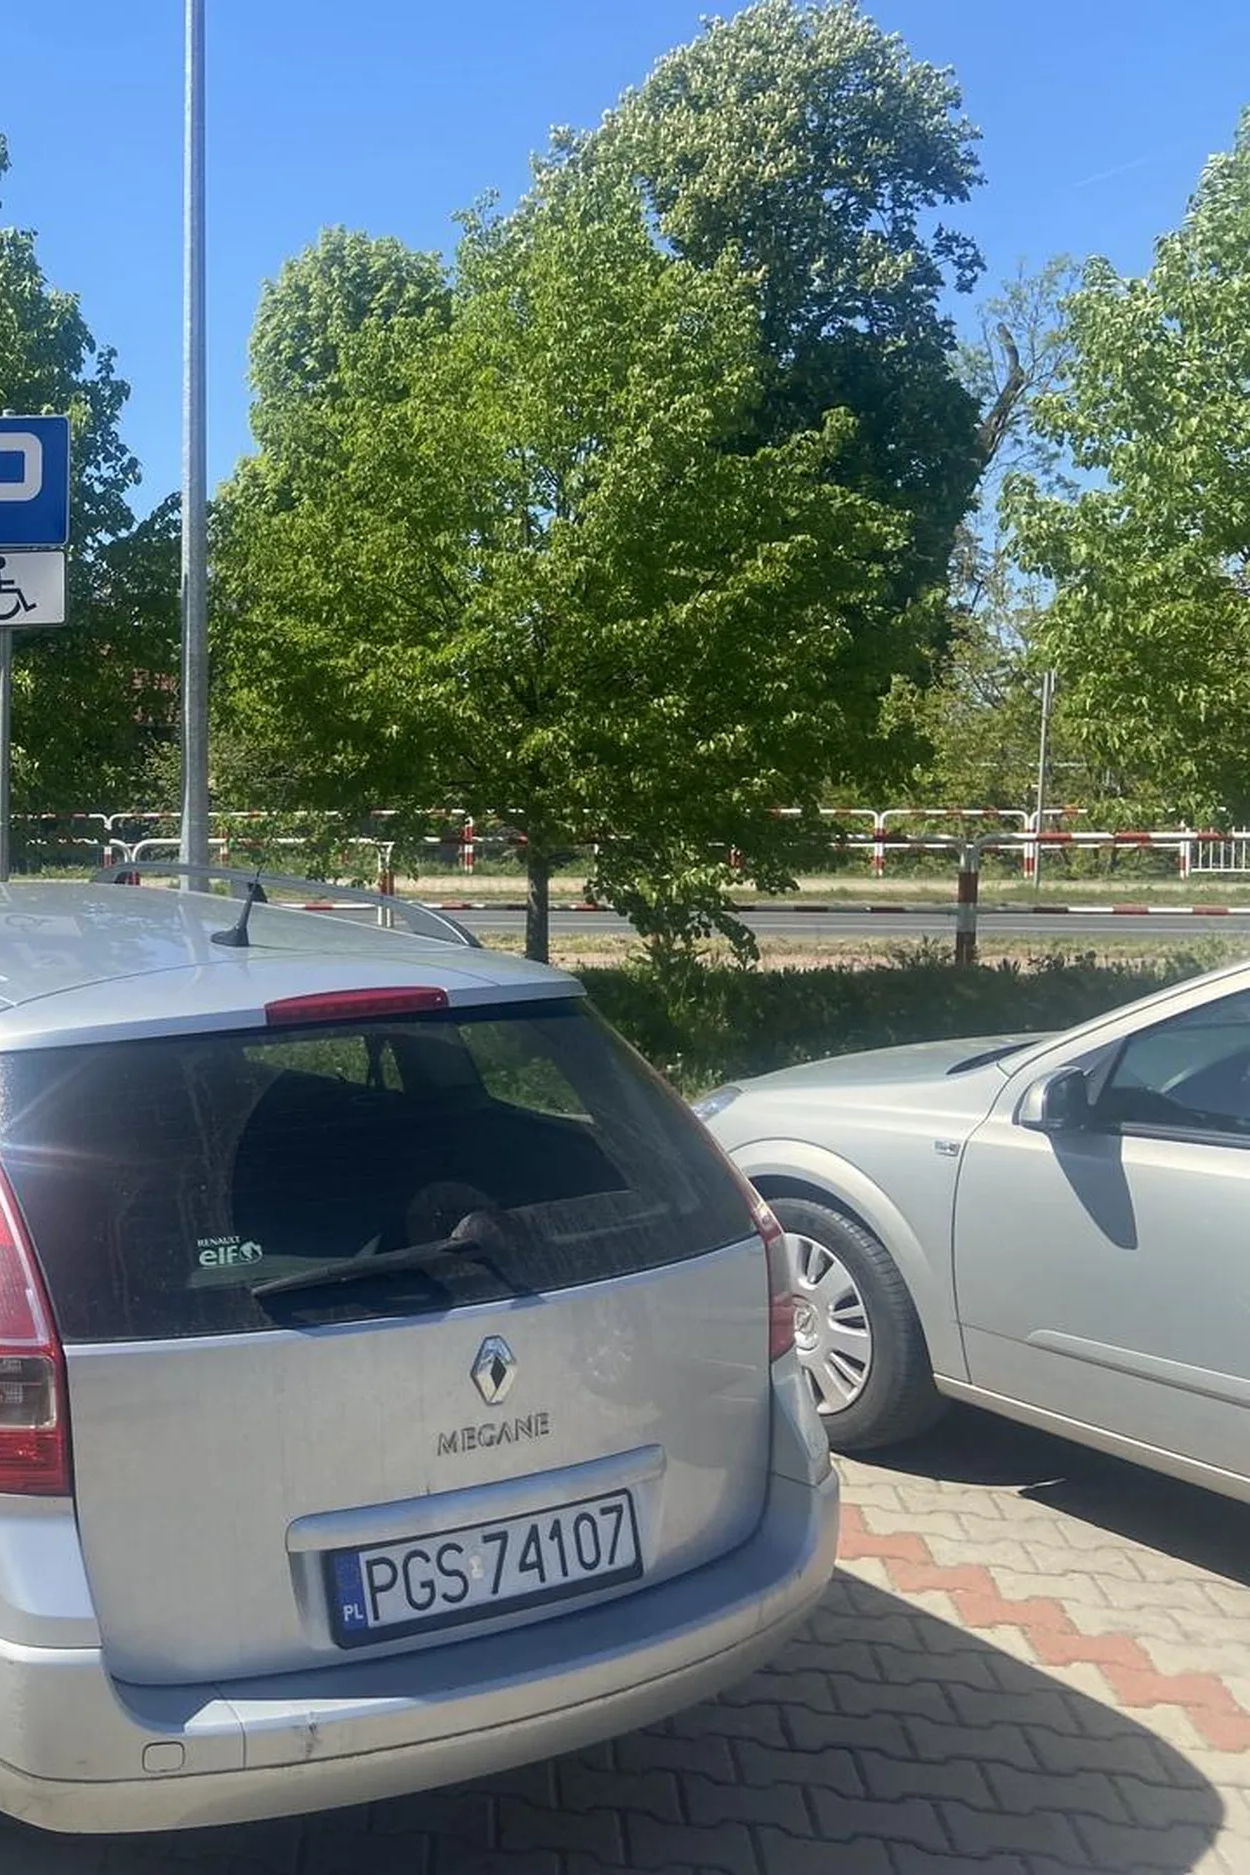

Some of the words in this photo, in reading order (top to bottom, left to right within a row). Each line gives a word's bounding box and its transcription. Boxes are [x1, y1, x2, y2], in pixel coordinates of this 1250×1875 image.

[197, 1235, 241, 1247] RENAULT
[199, 1245, 238, 1266] elf
[437, 1412, 550, 1456] MEGANE
[365, 1542, 470, 1621] PGS
[482, 1504, 623, 1594] 74107
[343, 1604, 364, 1622] PL
